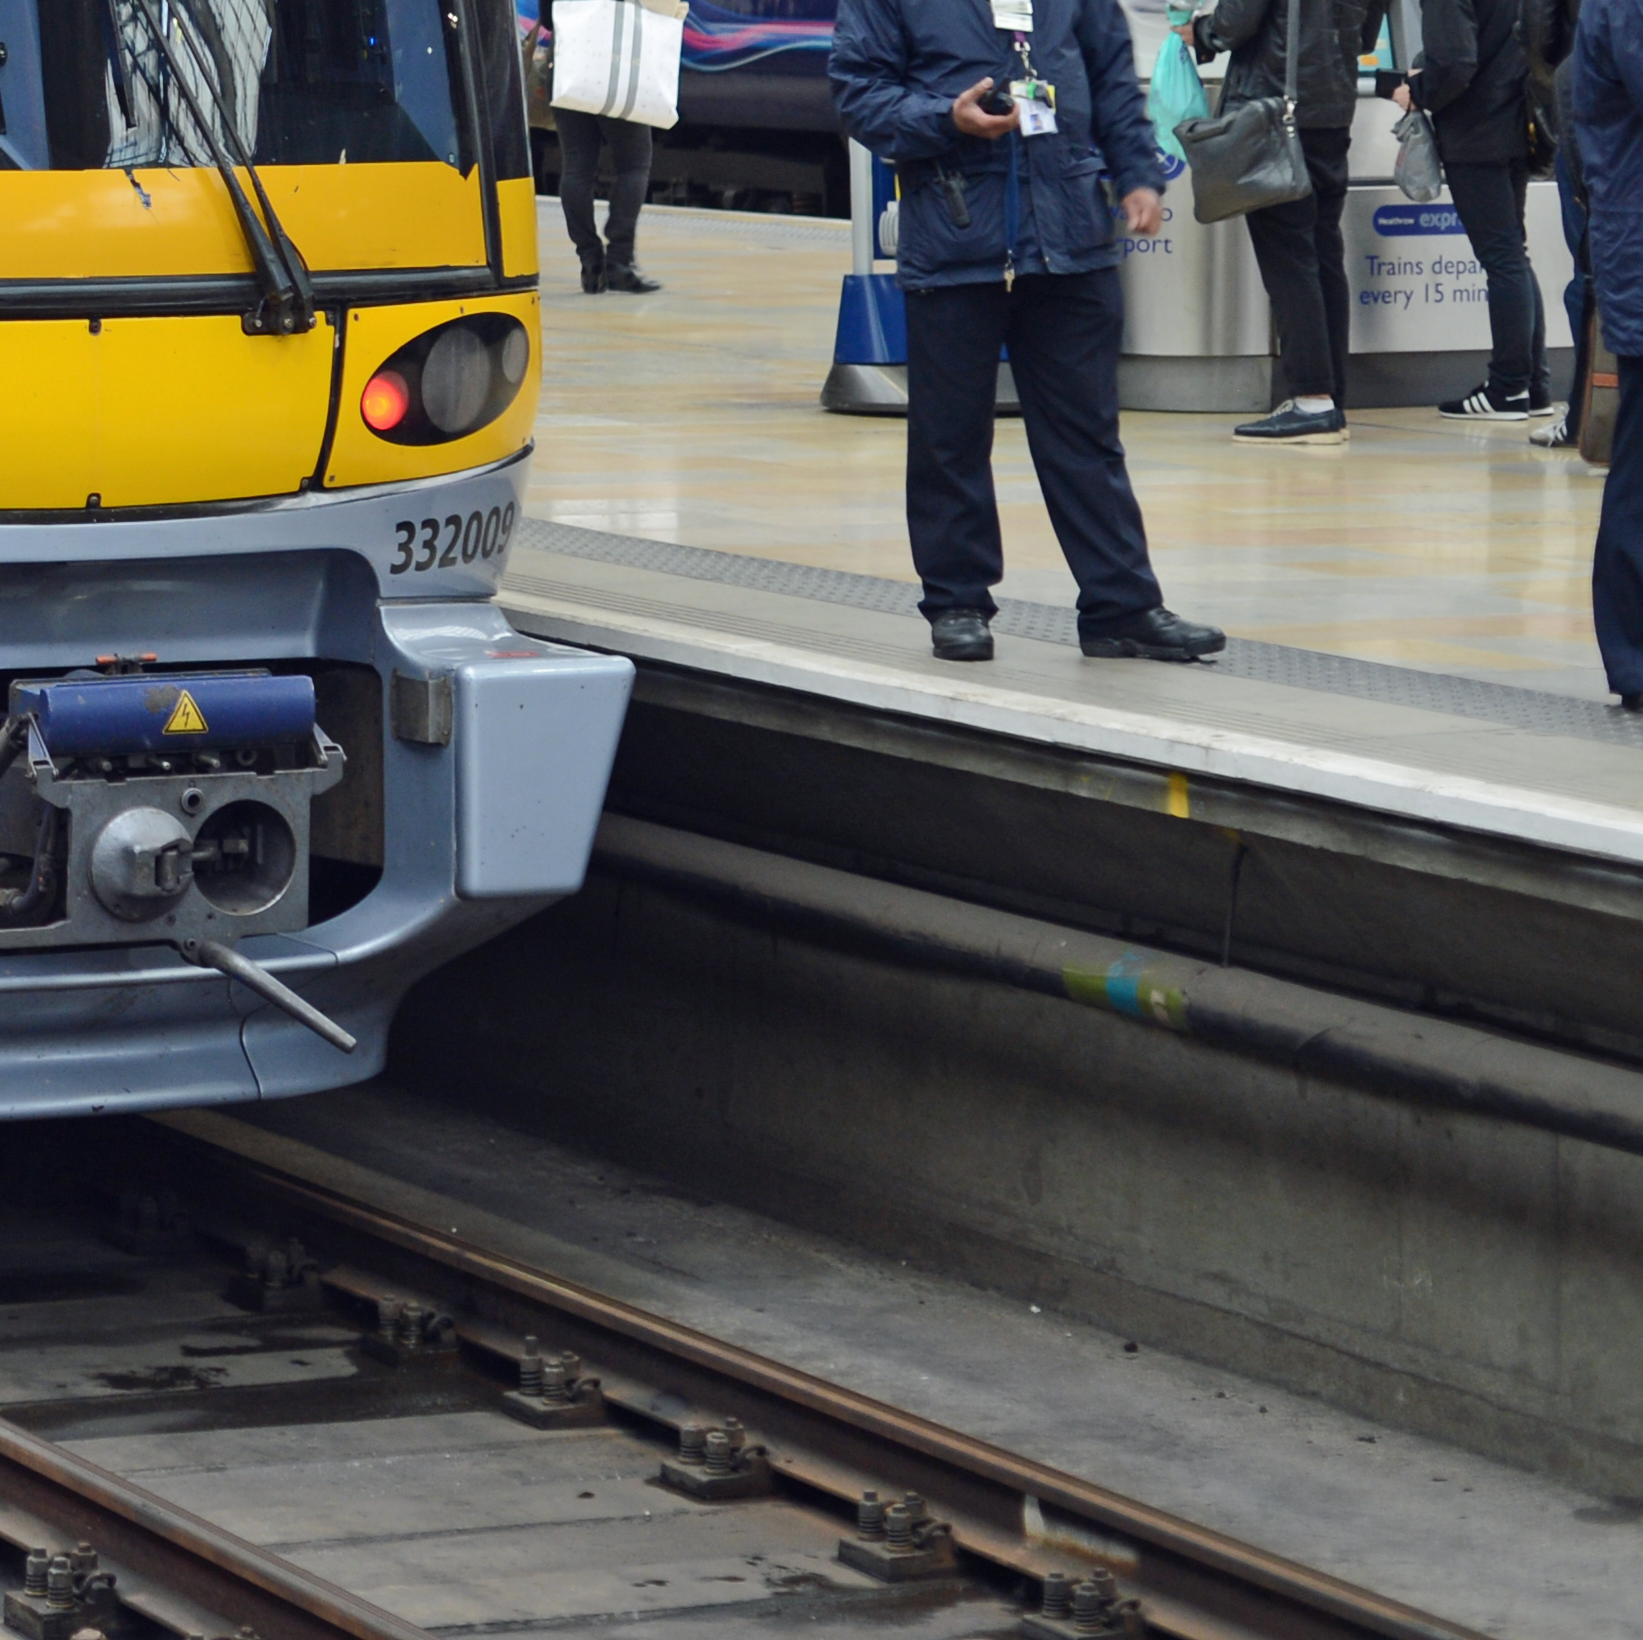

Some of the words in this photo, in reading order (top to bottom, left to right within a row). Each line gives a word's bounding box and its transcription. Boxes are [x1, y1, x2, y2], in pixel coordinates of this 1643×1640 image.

[1419, 212, 1462, 230] expr
[1116, 237, 1173, 258] port
[1365, 255, 1423, 276] Trains
[1431, 254, 1483, 280] depar
[1359, 289, 1413, 310] every
[1425, 283, 1444, 303] 15
[1453, 284, 1489, 302] min
[389, 501, 515, 575] 332009
